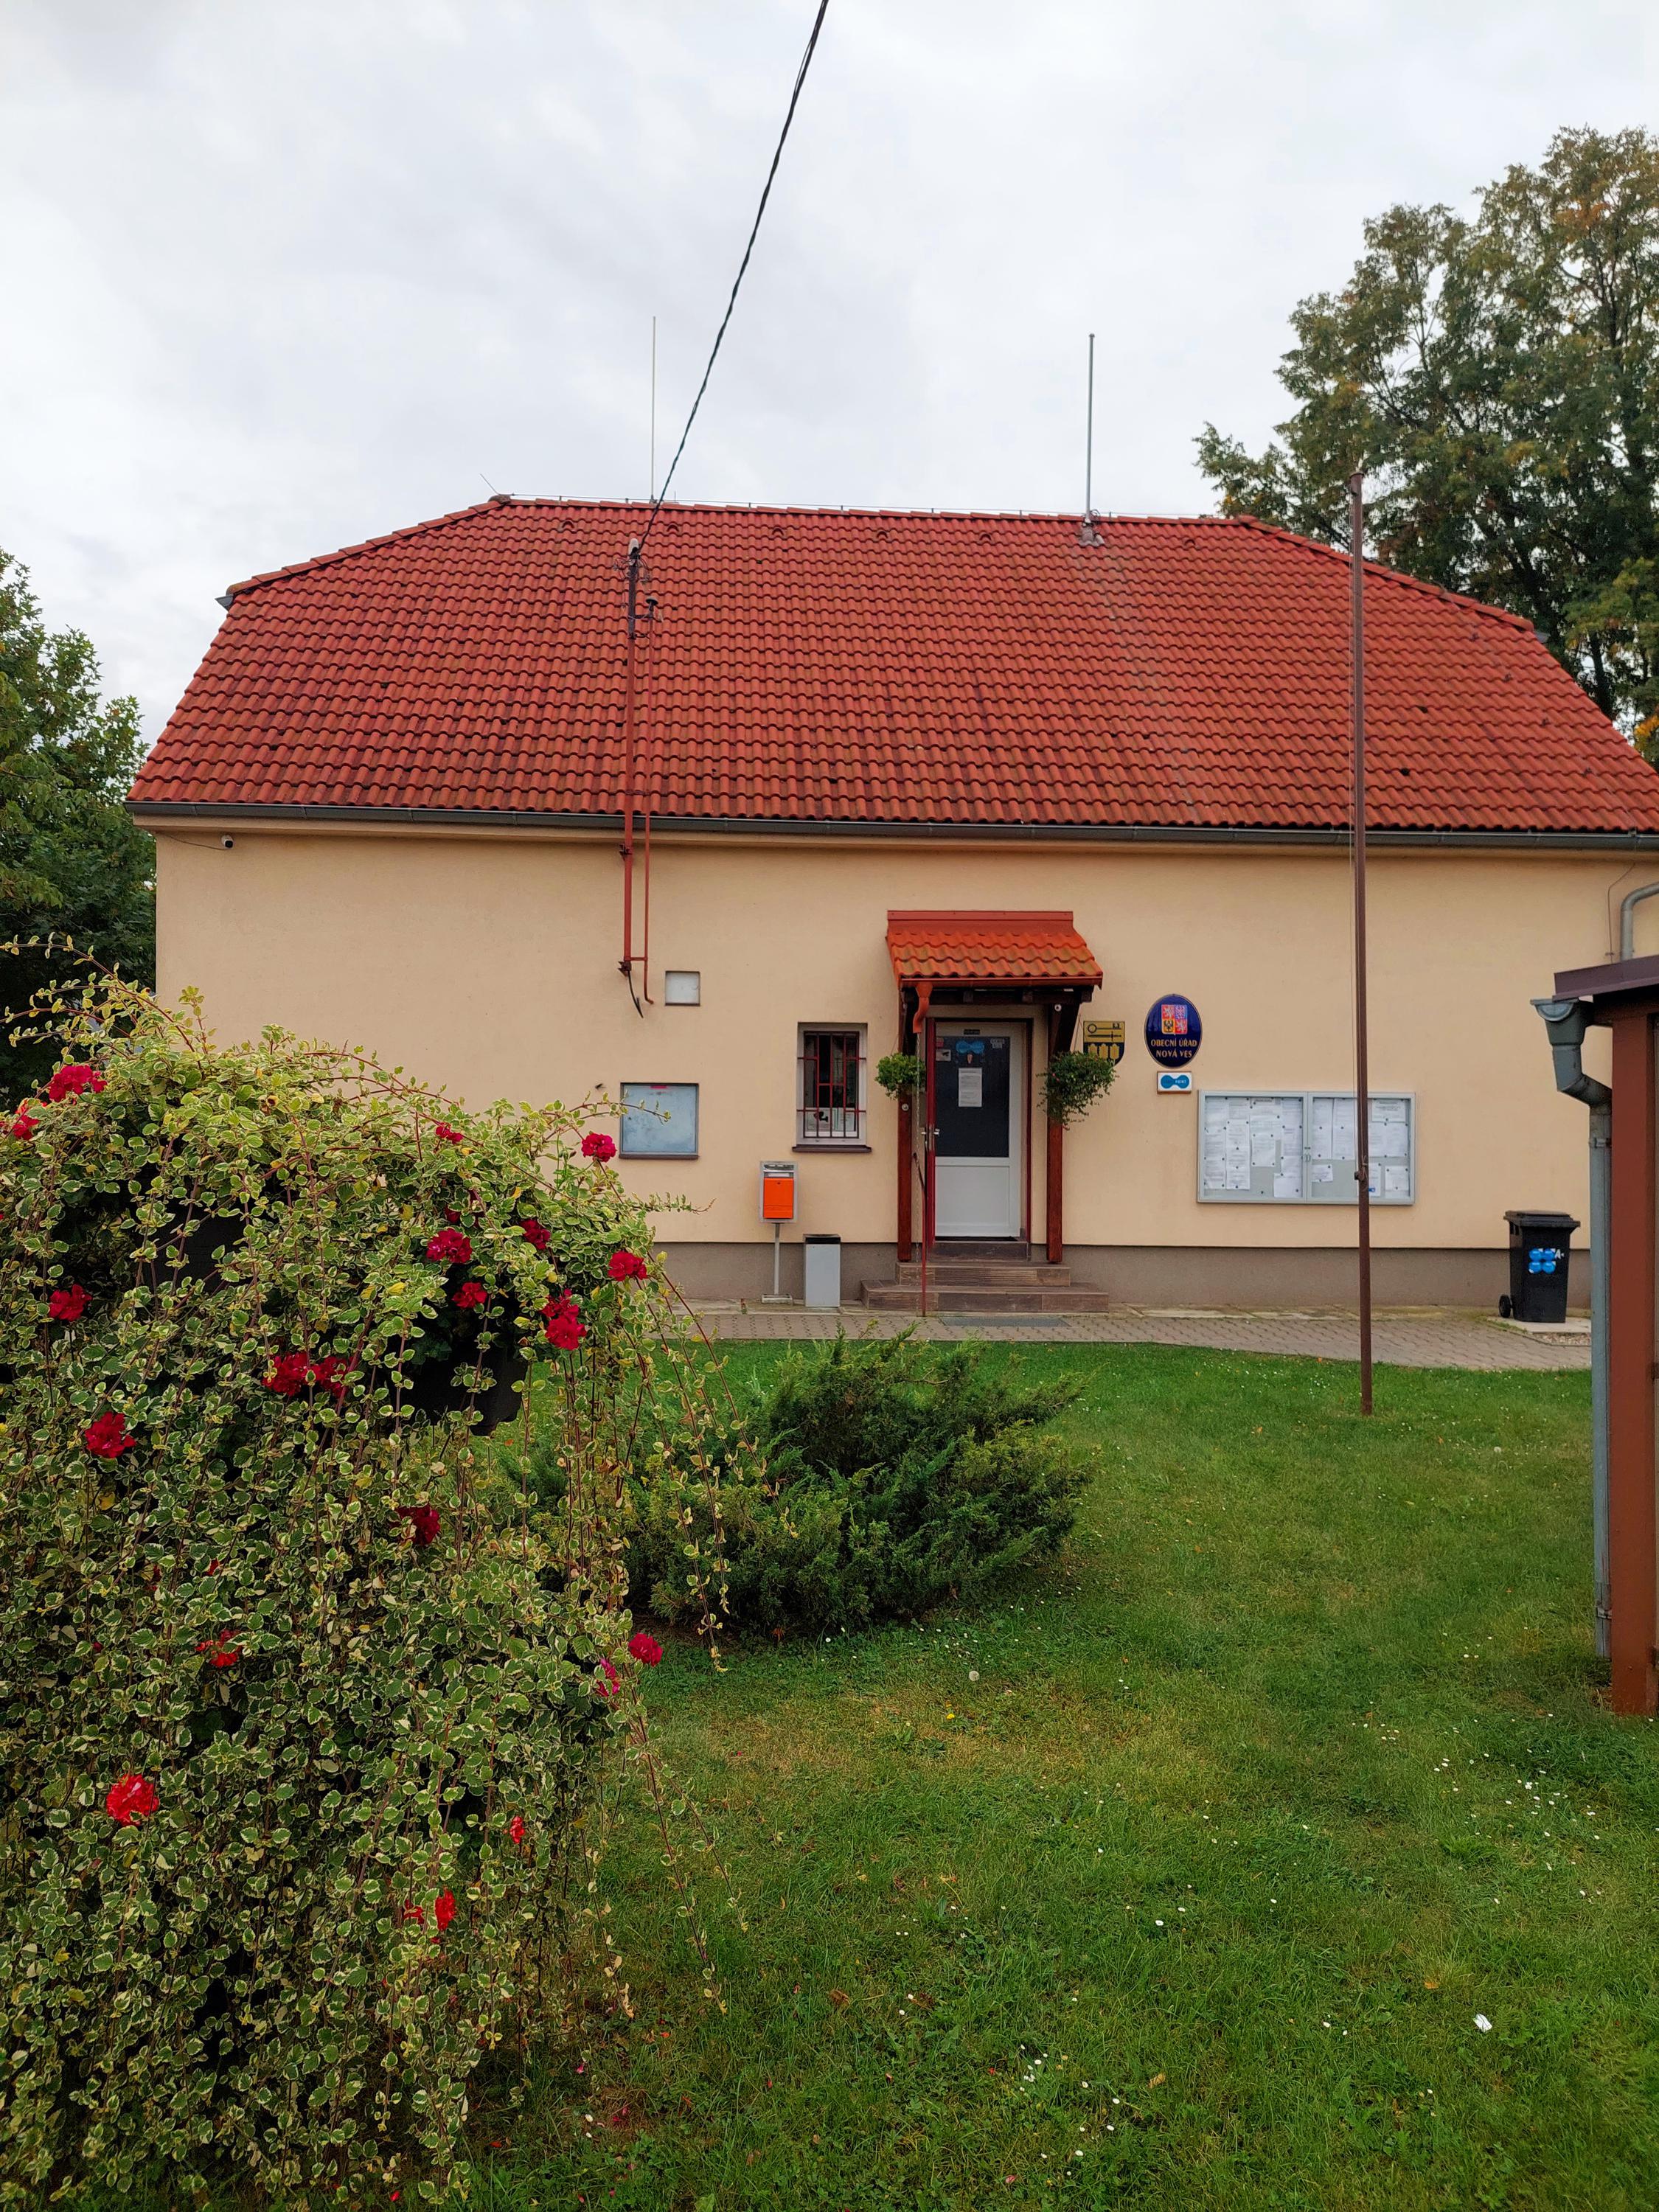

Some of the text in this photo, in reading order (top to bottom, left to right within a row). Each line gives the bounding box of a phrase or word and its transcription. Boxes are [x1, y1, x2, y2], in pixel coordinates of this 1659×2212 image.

[1150, 1038, 1197, 1047] OBECNÍ ÚŘAD
[1155, 1048, 1192, 1058] NOVÁ VES
